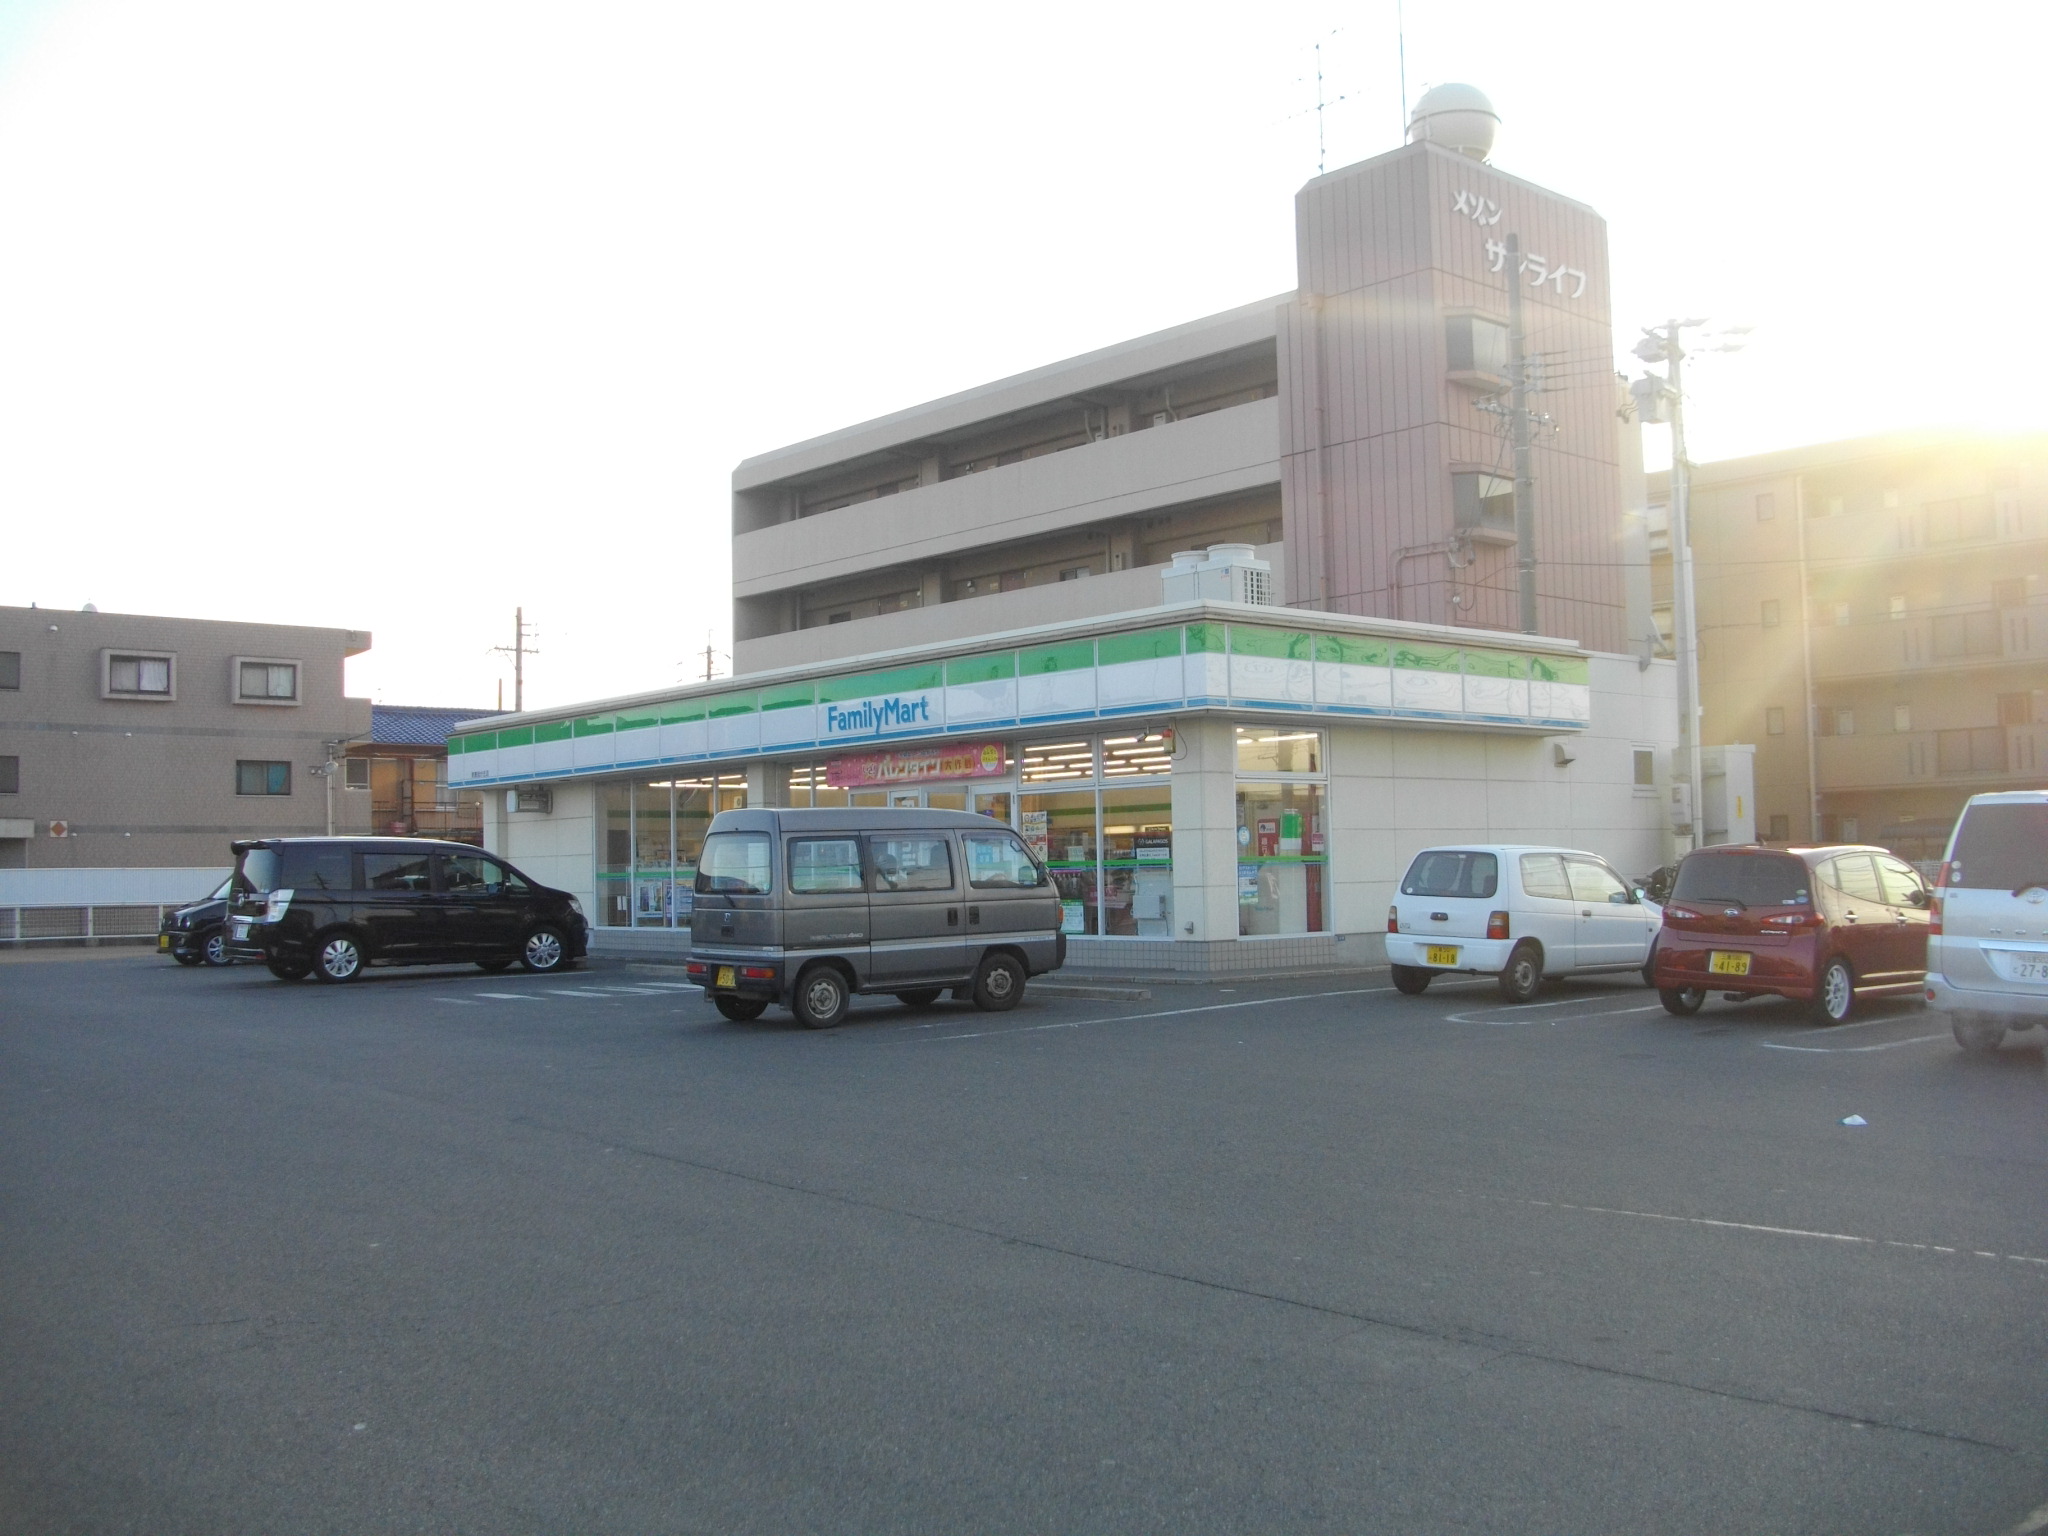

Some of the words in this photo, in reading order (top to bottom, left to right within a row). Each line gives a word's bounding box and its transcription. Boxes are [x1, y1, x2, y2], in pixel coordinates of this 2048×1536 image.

[1453, 189, 1502, 226] メゾン
[1485, 238, 1586, 299] サライフ
[827, 695, 929, 733] FamilyMart
[1433, 953, 1455, 964] 81-18
